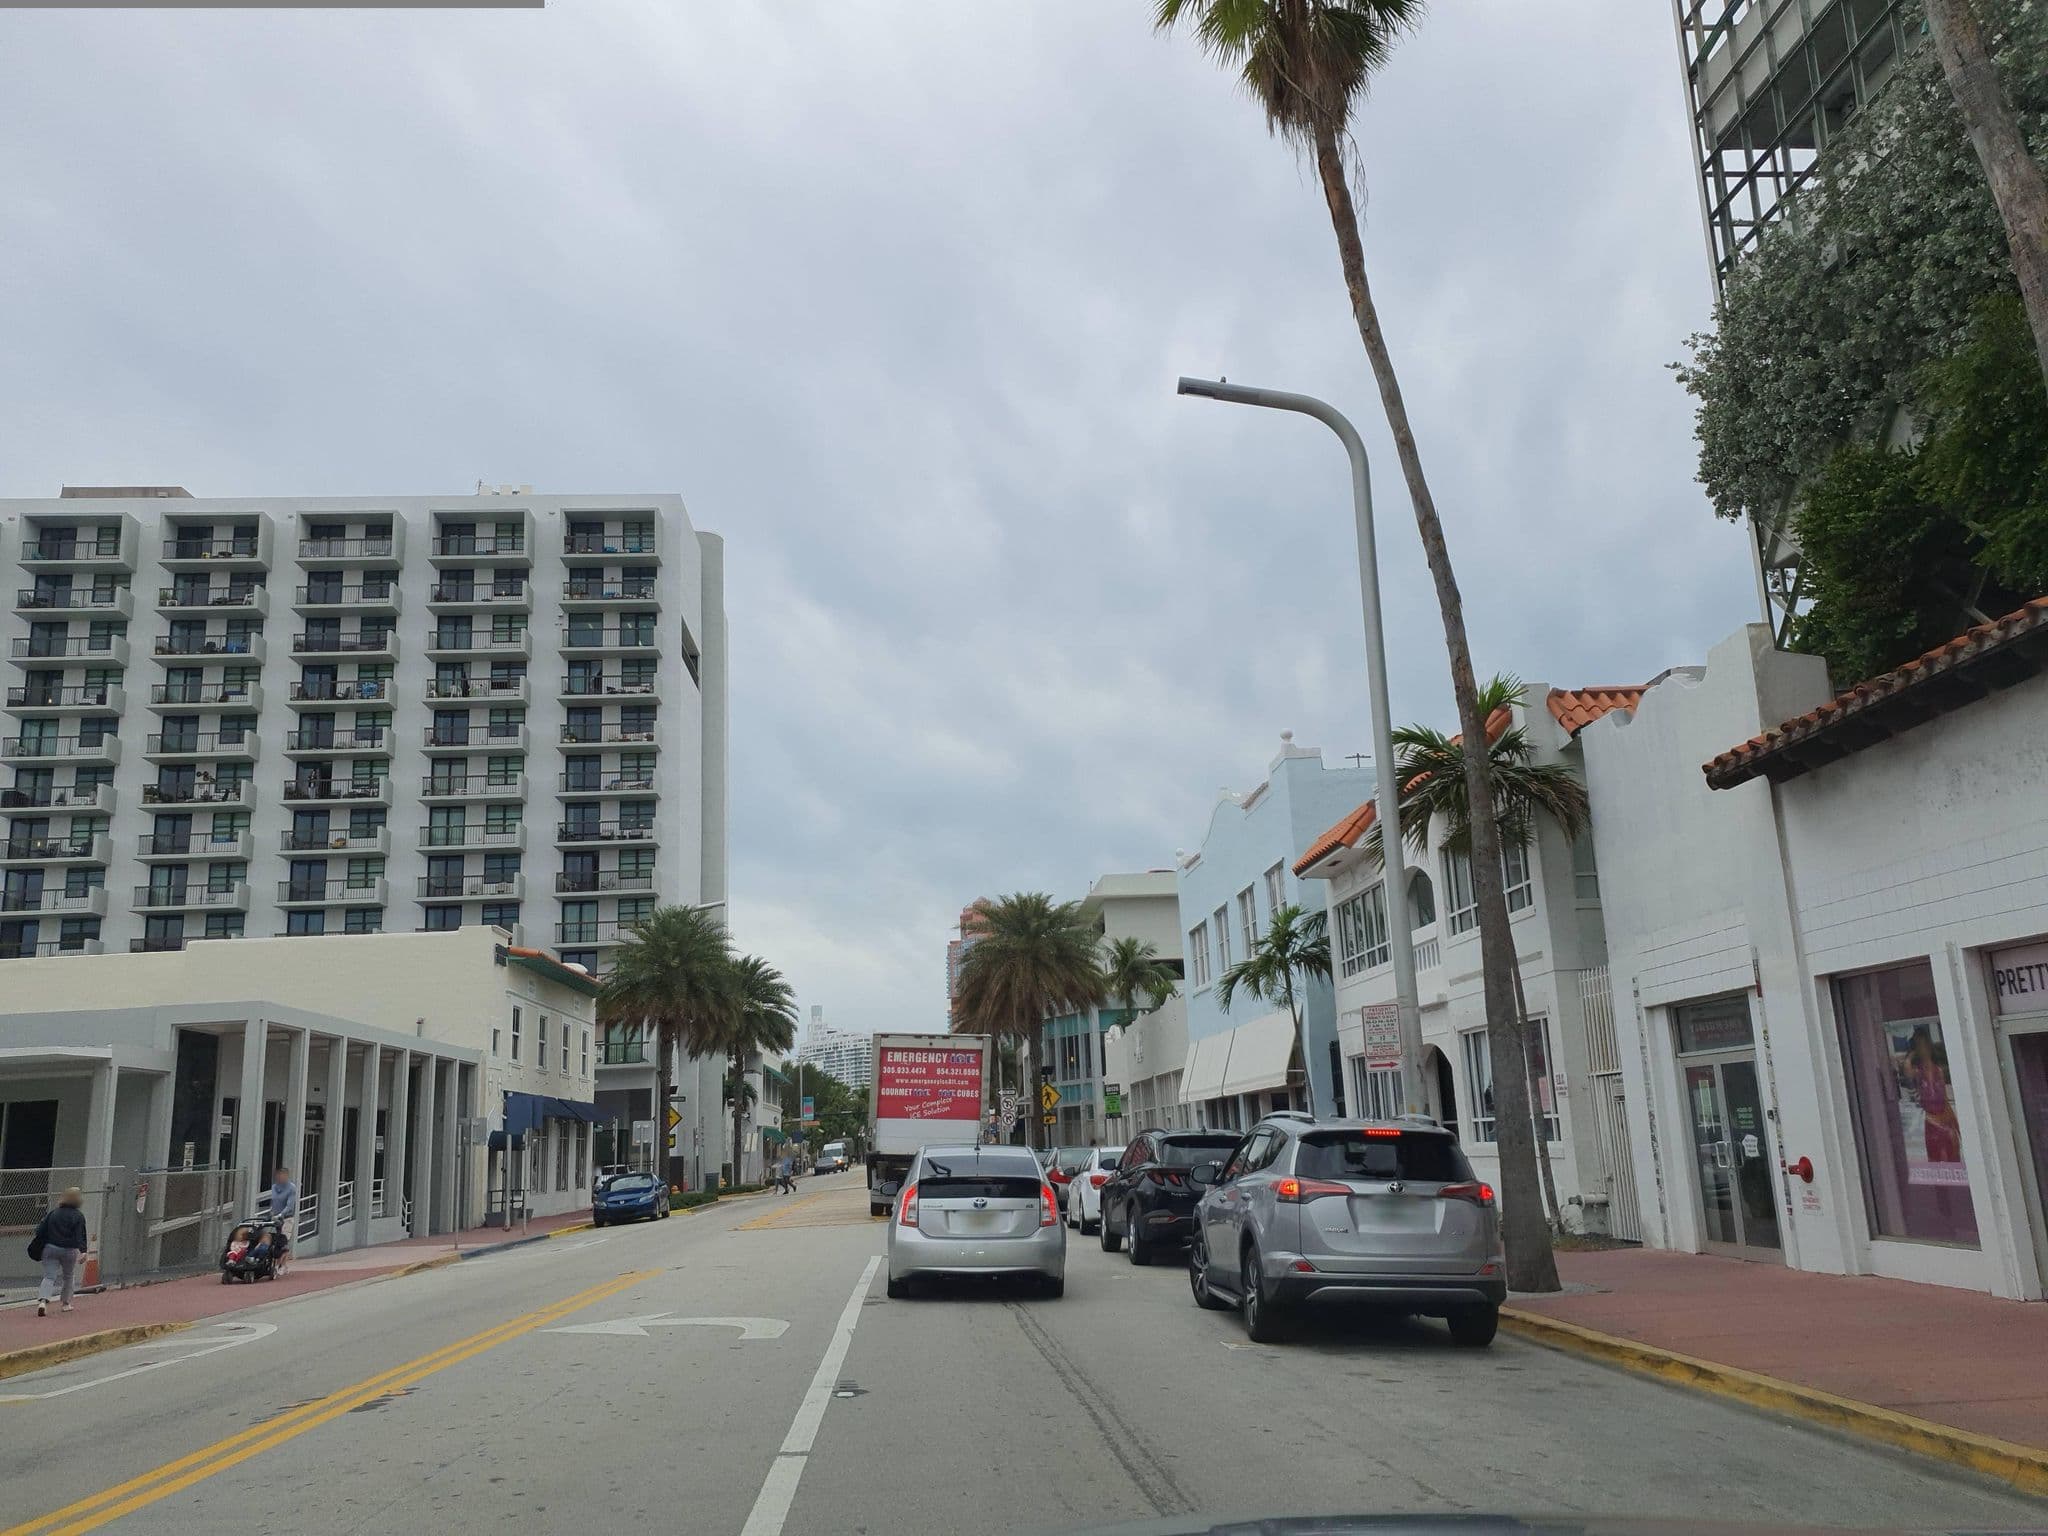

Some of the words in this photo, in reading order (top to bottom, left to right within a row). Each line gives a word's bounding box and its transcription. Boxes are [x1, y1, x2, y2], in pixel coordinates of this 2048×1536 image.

[887, 1051, 948, 1064] EMERGENCY
[950, 1053, 977, 1065] ICE
[881, 1088, 912, 1096] GOURMET
[957, 1090, 980, 1098] CUBES
[904, 1104, 920, 1112] Your
[922, 1097, 953, 1109] Complete
[923, 1106, 951, 1117] Solution
